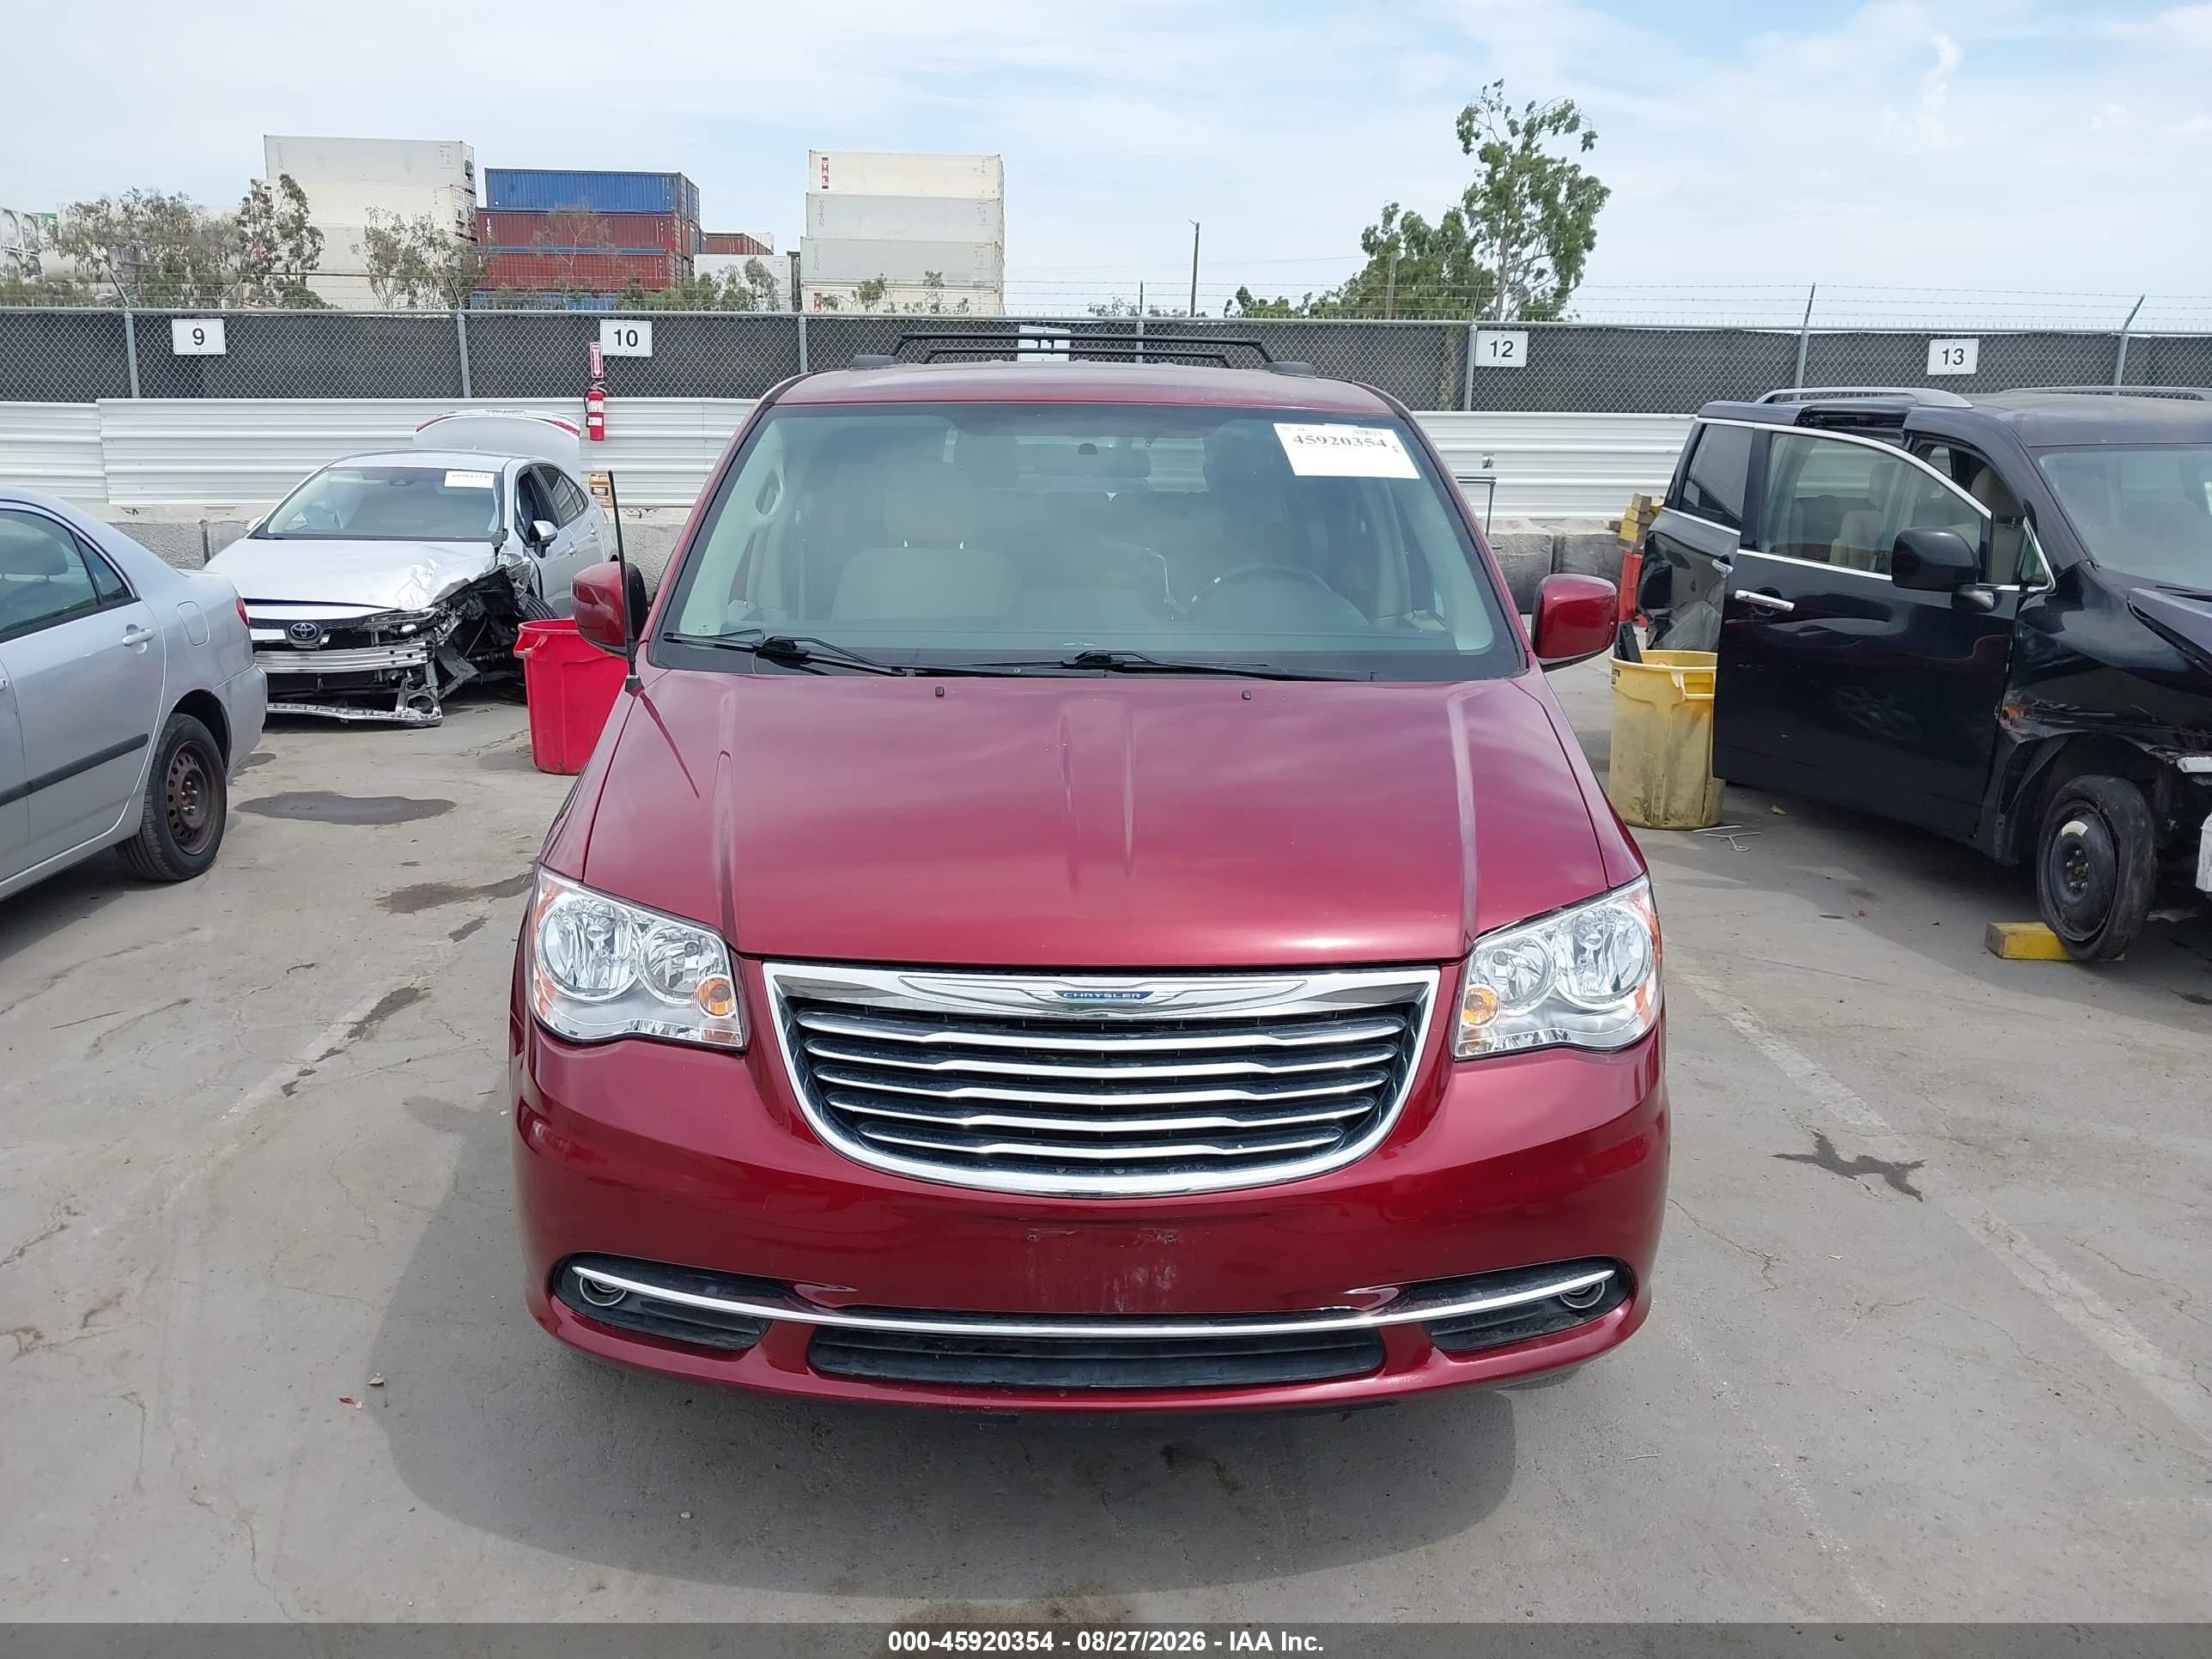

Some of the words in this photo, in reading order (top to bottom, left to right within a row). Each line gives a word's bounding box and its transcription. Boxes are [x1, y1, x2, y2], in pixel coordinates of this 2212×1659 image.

[192, 327, 205, 345] 9
[613, 329, 638, 347] 10
[1490, 340, 1514, 357] 12
[1942, 348, 1964, 365] 13
[1293, 434, 1387, 447] 45920354
